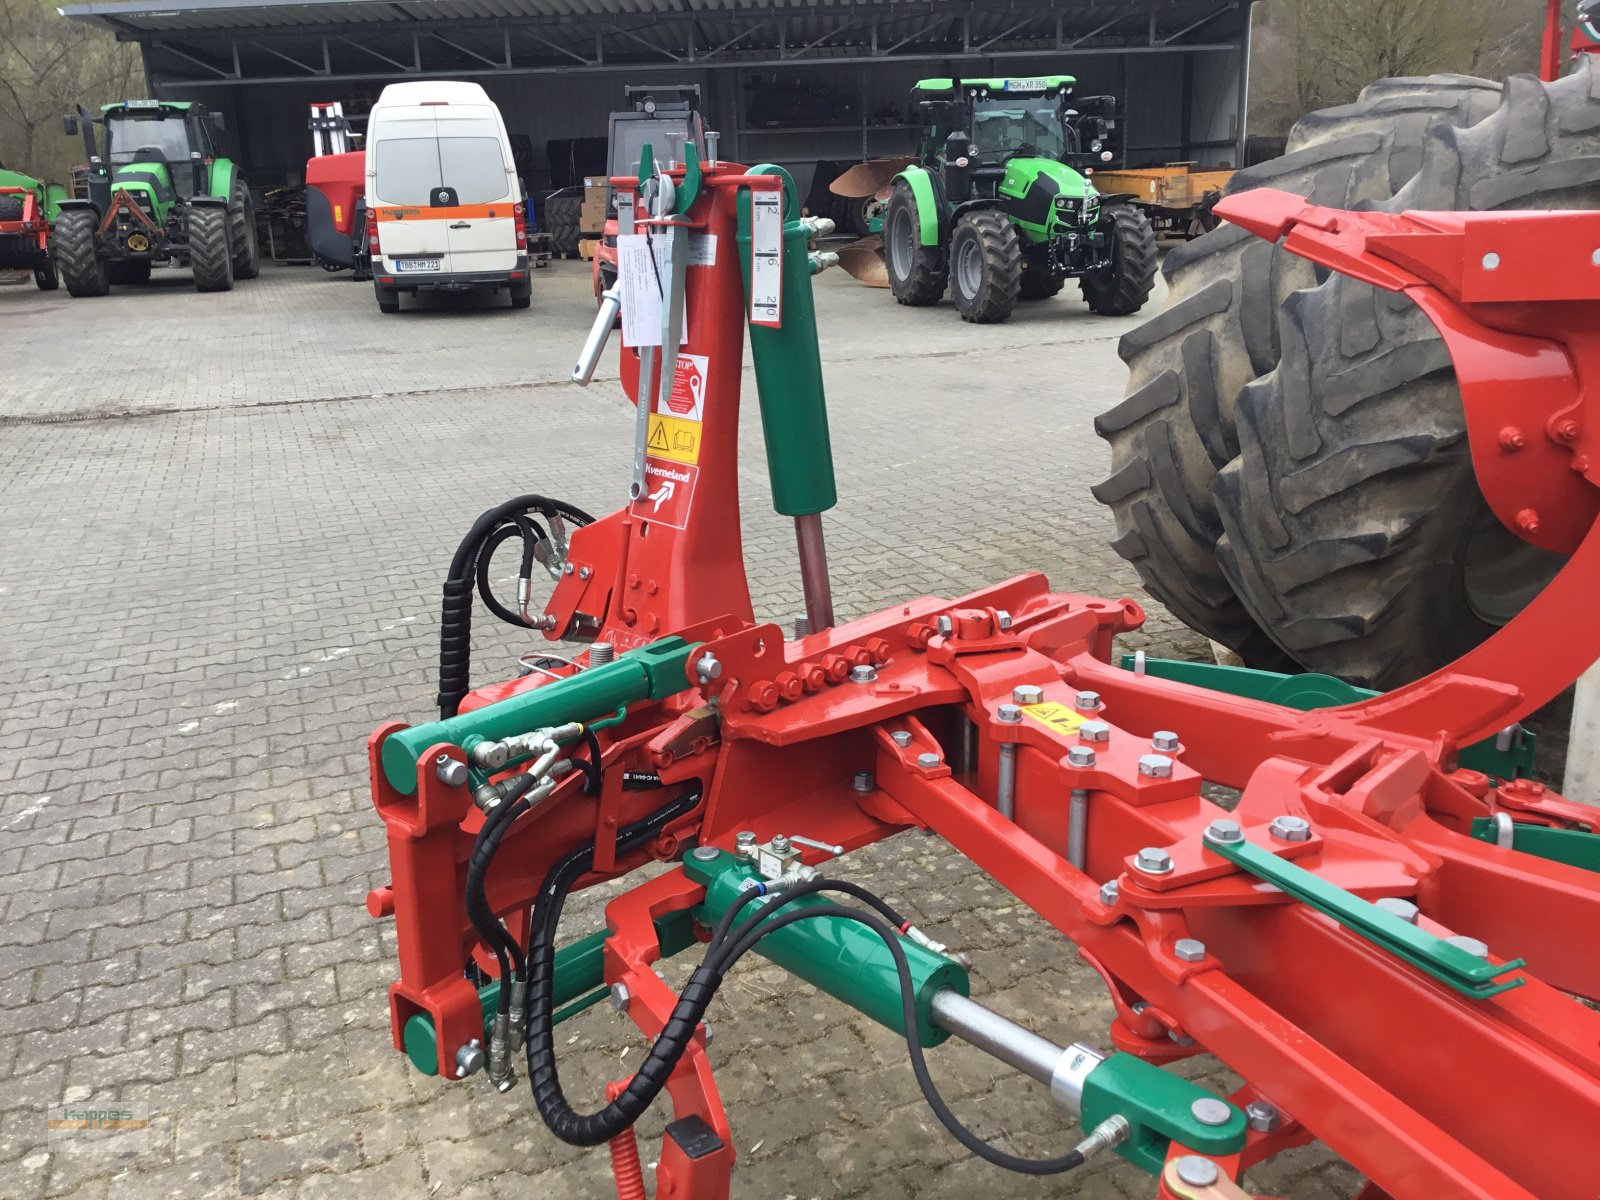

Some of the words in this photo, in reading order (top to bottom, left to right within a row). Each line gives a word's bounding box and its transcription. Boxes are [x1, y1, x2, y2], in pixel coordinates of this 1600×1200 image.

[400, 261, 414, 269] TBB
[417, 260, 427, 269] HM
[675, 359, 694, 371] TOP!
[645, 462, 690, 483] Kverneland
